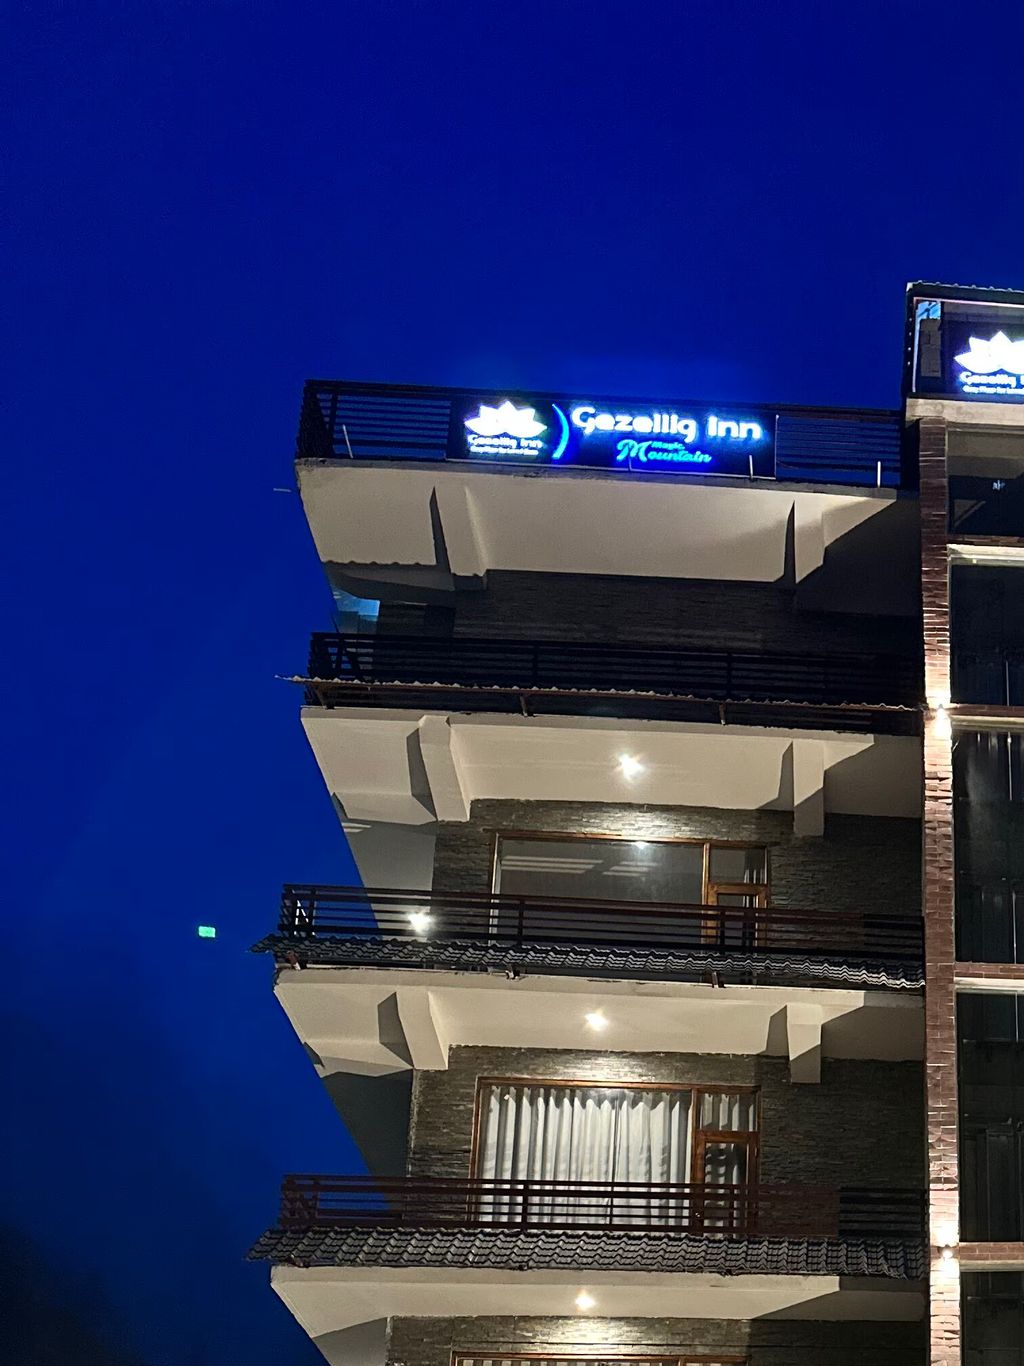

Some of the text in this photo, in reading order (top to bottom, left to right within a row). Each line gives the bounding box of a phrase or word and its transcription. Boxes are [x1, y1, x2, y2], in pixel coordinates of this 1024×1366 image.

[571, 406, 762, 443] Gezellig Inn
[616, 439, 712, 463] Mountain
